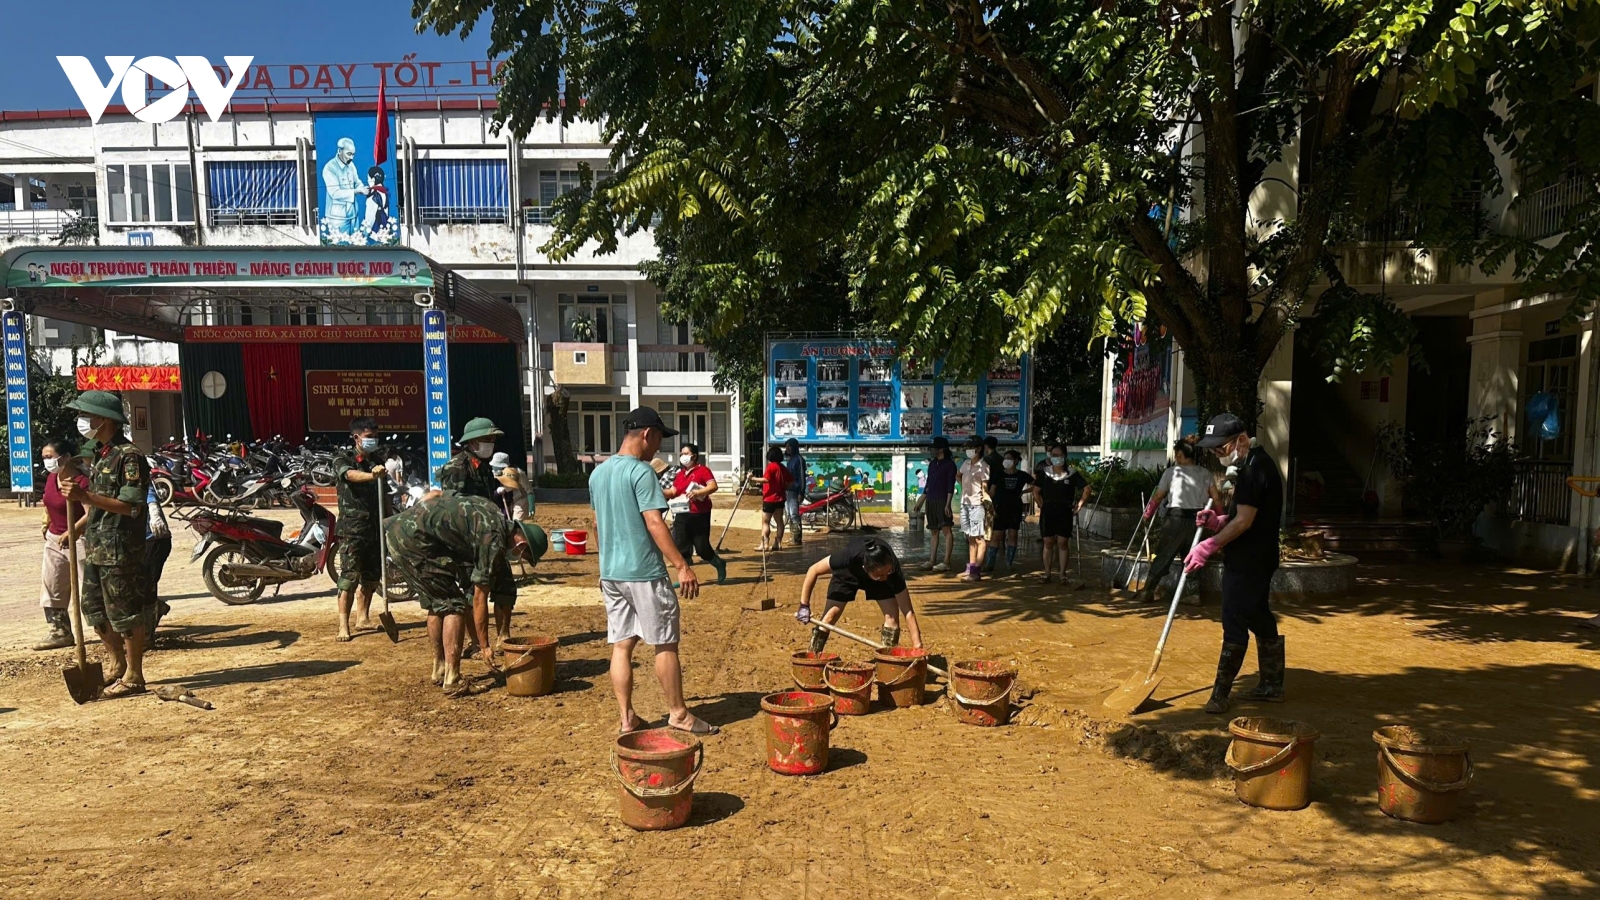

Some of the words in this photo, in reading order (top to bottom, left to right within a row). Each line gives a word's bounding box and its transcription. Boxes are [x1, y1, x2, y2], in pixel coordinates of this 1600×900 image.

[288, 64, 357, 94] DẠY
[373, 52, 442, 88] TỐT
[50, 259, 85, 276] NGÔI
[88, 259, 148, 276] TRƯỜNG
[150, 259, 190, 276] THÂN
[193, 259, 237, 279] THIỆN
[250, 259, 291, 276] NÂNG
[294, 259, 334, 276] CÁNH
[337, 259, 366, 276] ƯỚC
[369, 261, 394, 275] MƠ
[7, 333, 20, 341] BAO
[193, 328, 221, 338] NƯỚC
[223, 329, 251, 339] CỘNG
[299, 328, 317, 339] HỘI
[320, 327, 341, 338] CHỦ
[345, 327, 378, 338] NGHĨA
[382, 327, 406, 339] VIỆT
[447, 328, 469, 338] UÔN
[472, 327, 496, 338] NĂM
[430, 345, 442, 355] THẾ
[9, 362, 22, 371] HOA
[430, 375, 444, 386] TẬN
[312, 385, 338, 394] SINH
[342, 385, 368, 396] HOẠT
[374, 384, 399, 394] DƯỚI
[404, 383, 418, 394] CỜ
[11, 406, 25, 416] HỌC
[433, 405, 443, 415] CÔ
[12, 421, 25, 430] TRÒ
[430, 419, 446, 430] THẦY
[433, 434, 445, 444] MÃI
[13, 448, 28, 459] CHẤT
[431, 450, 448, 459] VINH
[12, 465, 30, 475] NGỌC
